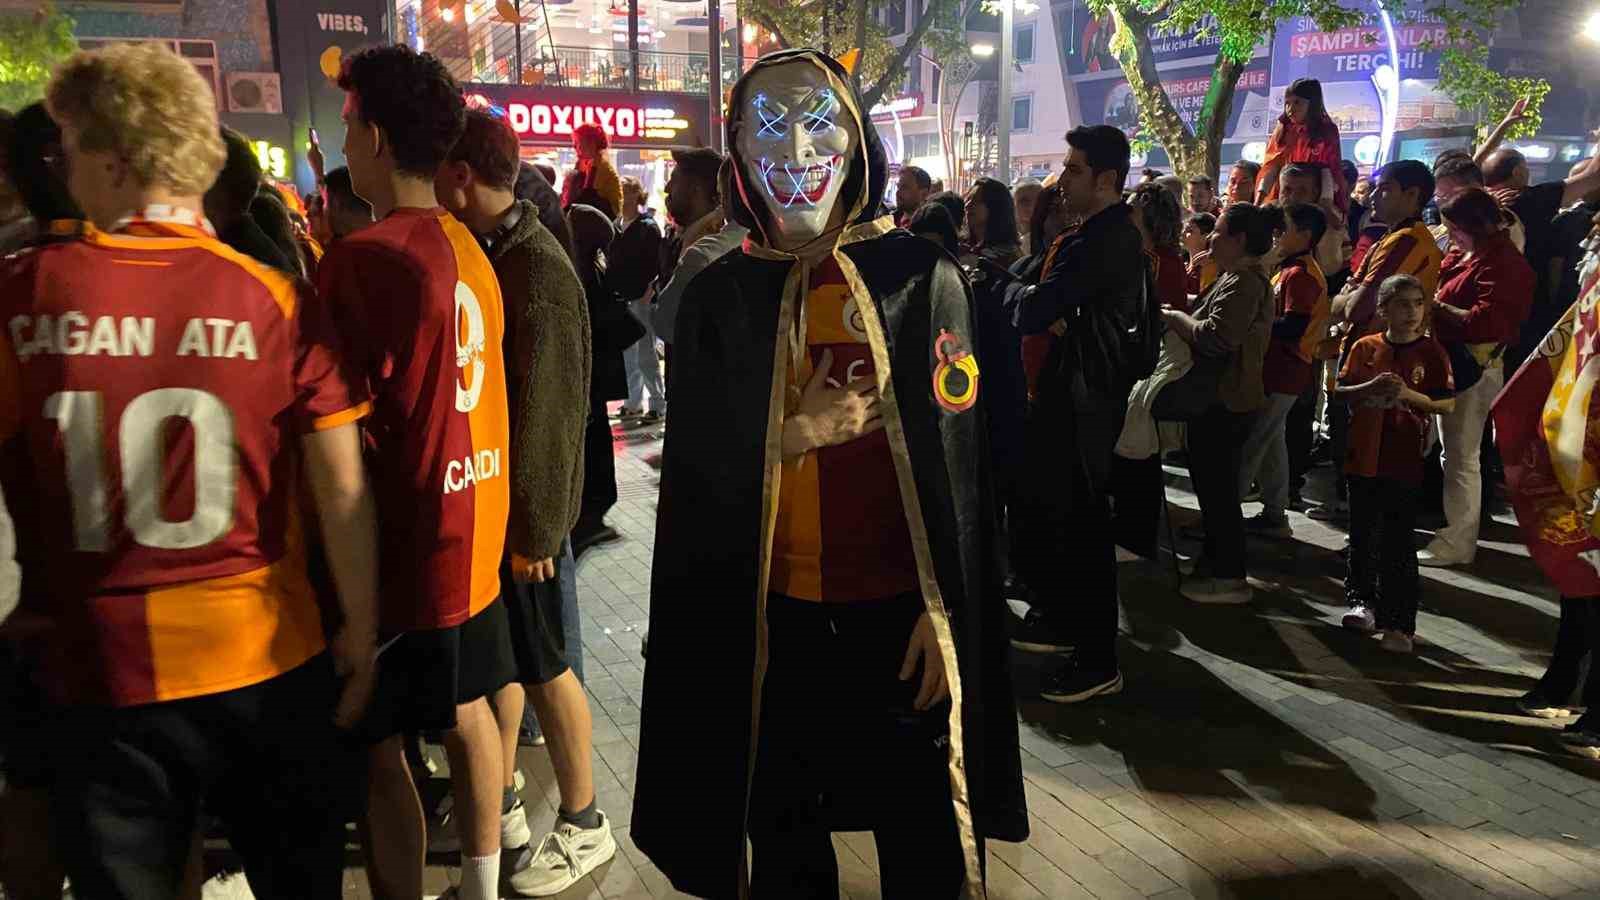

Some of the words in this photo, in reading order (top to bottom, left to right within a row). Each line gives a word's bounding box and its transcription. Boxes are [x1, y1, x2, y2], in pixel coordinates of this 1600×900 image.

[317, 12, 368, 35] VIBES,
[1334, 48, 1424, 72] TERCHİ!
[176, 318, 259, 361] ATA
[454, 280, 486, 413] 9
[42, 387, 238, 551] 10
